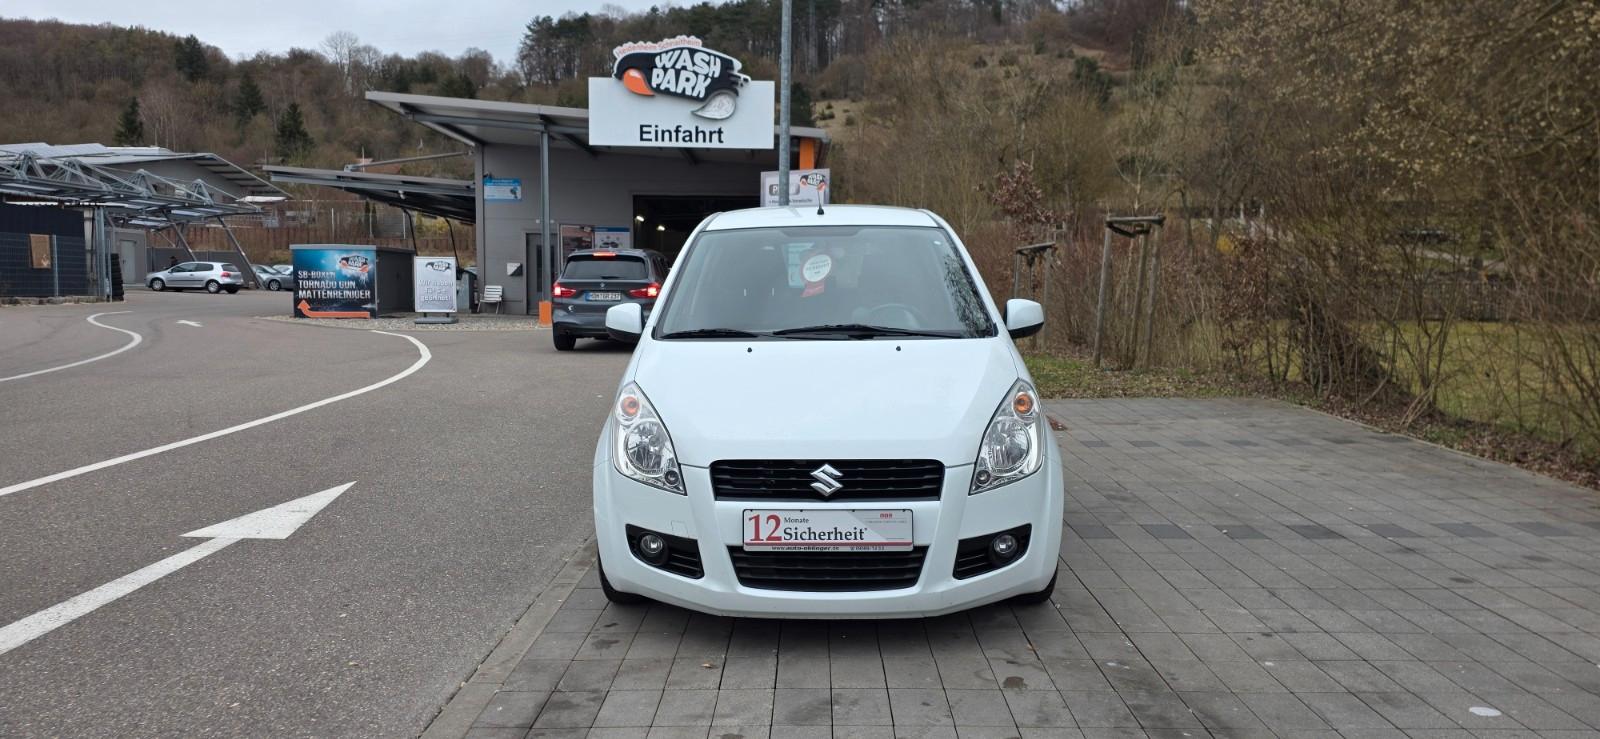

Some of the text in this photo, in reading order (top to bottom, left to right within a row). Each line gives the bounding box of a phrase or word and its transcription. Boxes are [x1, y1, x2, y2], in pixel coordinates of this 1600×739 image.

[655, 49, 721, 78] WASH
[651, 67, 712, 98] PARK
[639, 124, 724, 144] Einfahrt
[298, 280, 356, 289] TORNADO GUN
[298, 289, 371, 299] MATTENREINIGER
[748, 514, 782, 541] 12
